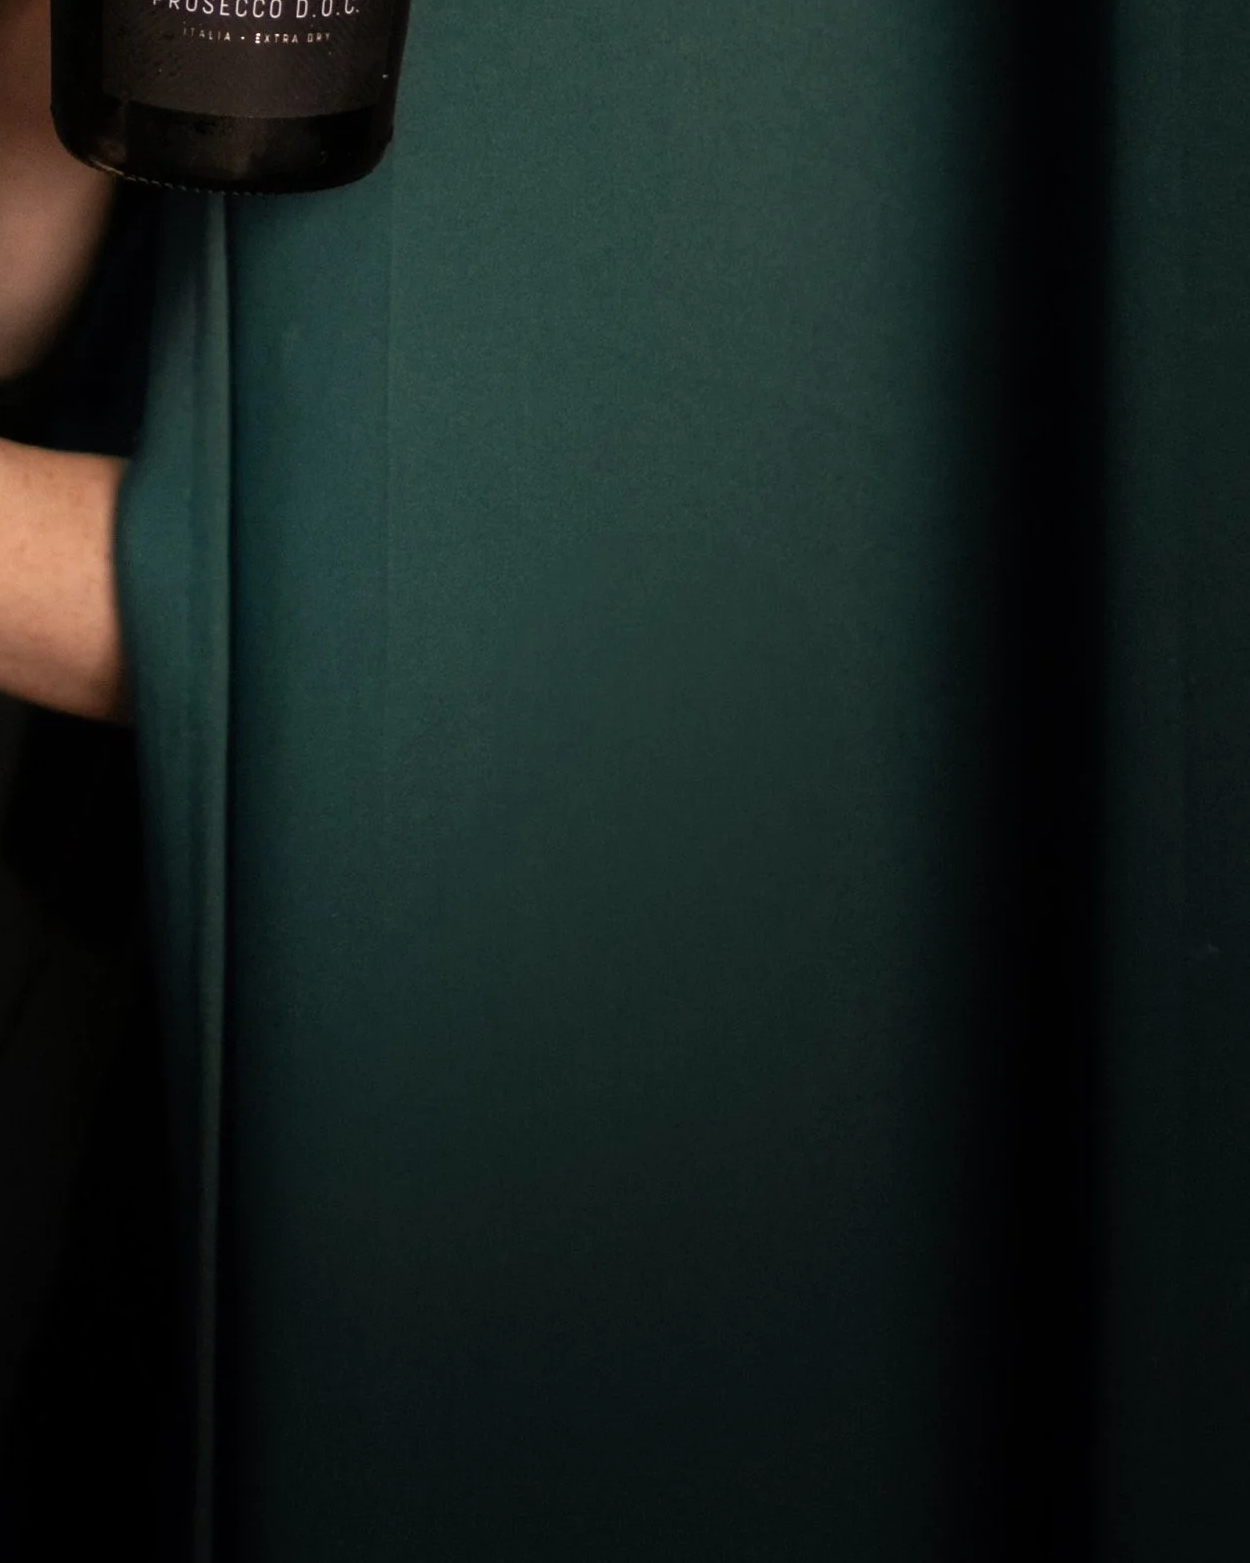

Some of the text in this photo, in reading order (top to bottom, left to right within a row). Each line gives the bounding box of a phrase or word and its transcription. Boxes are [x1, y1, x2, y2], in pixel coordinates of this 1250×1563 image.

[182, 27, 331, 44] ITALIA EXTRA DRY
